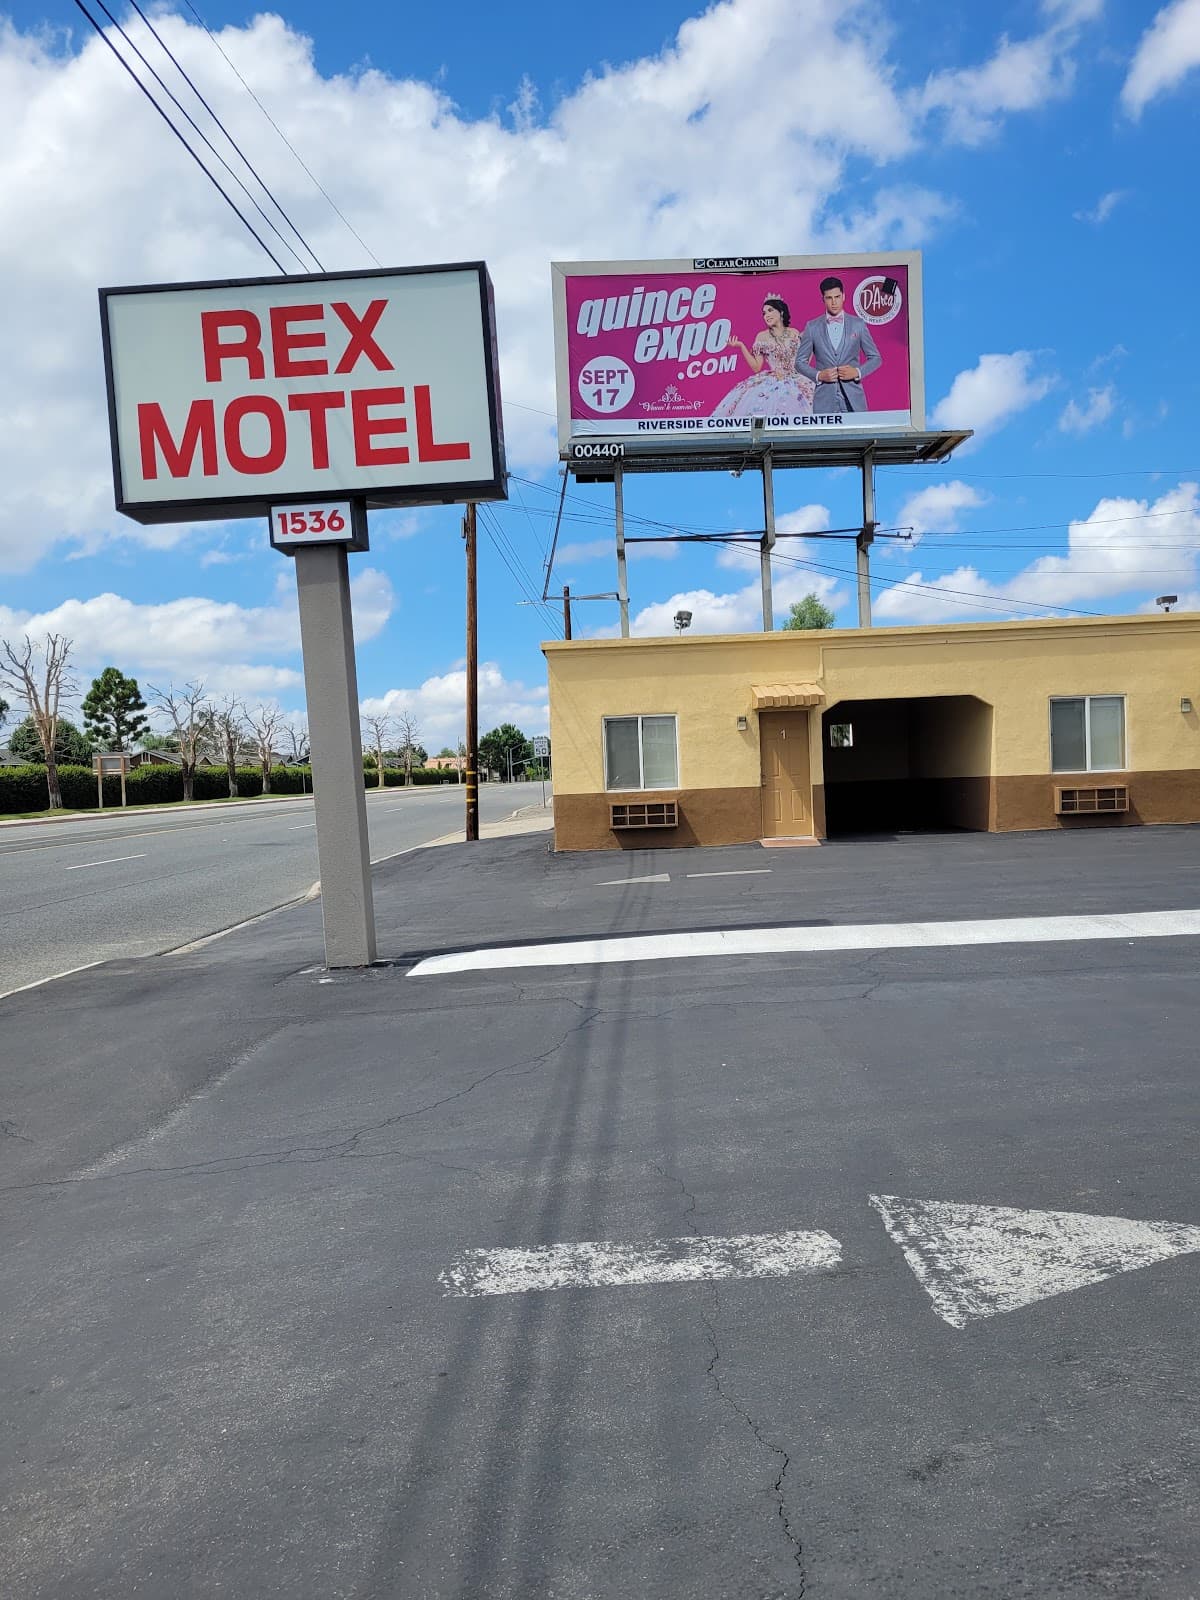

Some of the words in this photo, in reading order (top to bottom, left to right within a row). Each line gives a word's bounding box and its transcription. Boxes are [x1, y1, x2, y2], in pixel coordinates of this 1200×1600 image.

[576, 283, 717, 338] quince
[200, 299, 395, 383] REX
[633, 318, 732, 364] expo
[581, 369, 629, 385] SEPT
[592, 388, 620, 406] 17
[137, 384, 471, 481] MOTEL
[638, 418, 704, 430] RIVERSIDE
[707, 416, 789, 429] CONVEION
[794, 414, 843, 426] CENTER
[574, 443, 625, 458] 004401
[277, 508, 345, 536] 1536
